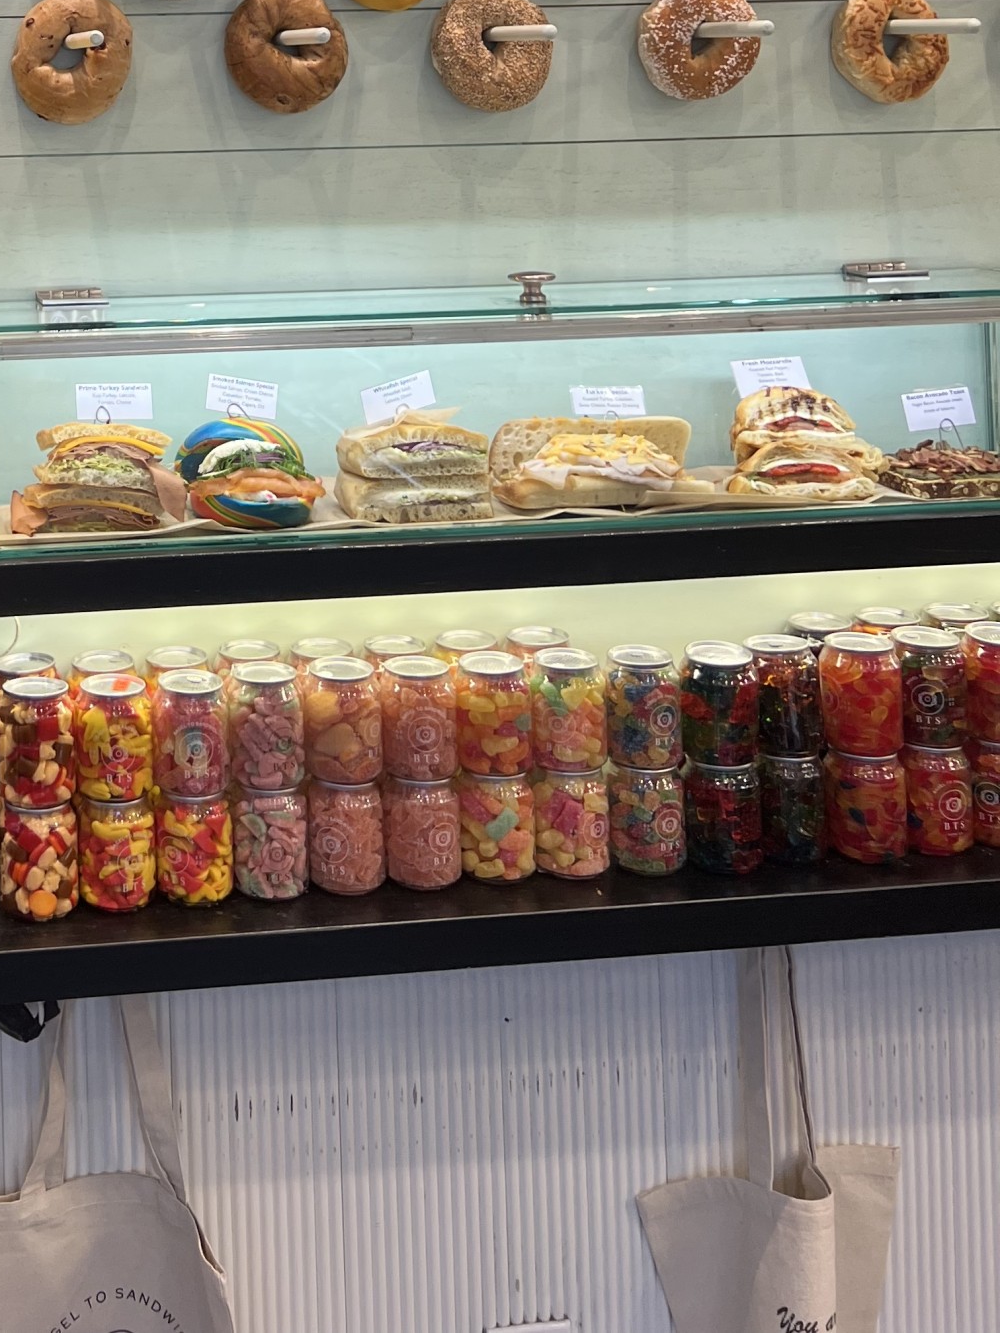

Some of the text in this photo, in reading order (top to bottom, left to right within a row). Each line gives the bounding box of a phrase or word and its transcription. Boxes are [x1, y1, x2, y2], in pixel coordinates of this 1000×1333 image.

[916, 714, 942, 725] BTS
[655, 736, 676, 746] BTS
[413, 753, 440, 763] BTS
[106, 772, 133, 784] BTS
[944, 820, 966, 831] BTS
[660, 841, 681, 852] BTS
[320, 862, 346, 875] BTS
[84, 1290, 107, 1309] TO
[115, 1287, 184, 1333] SANDWI
[777, 1306, 819, 1333] You
